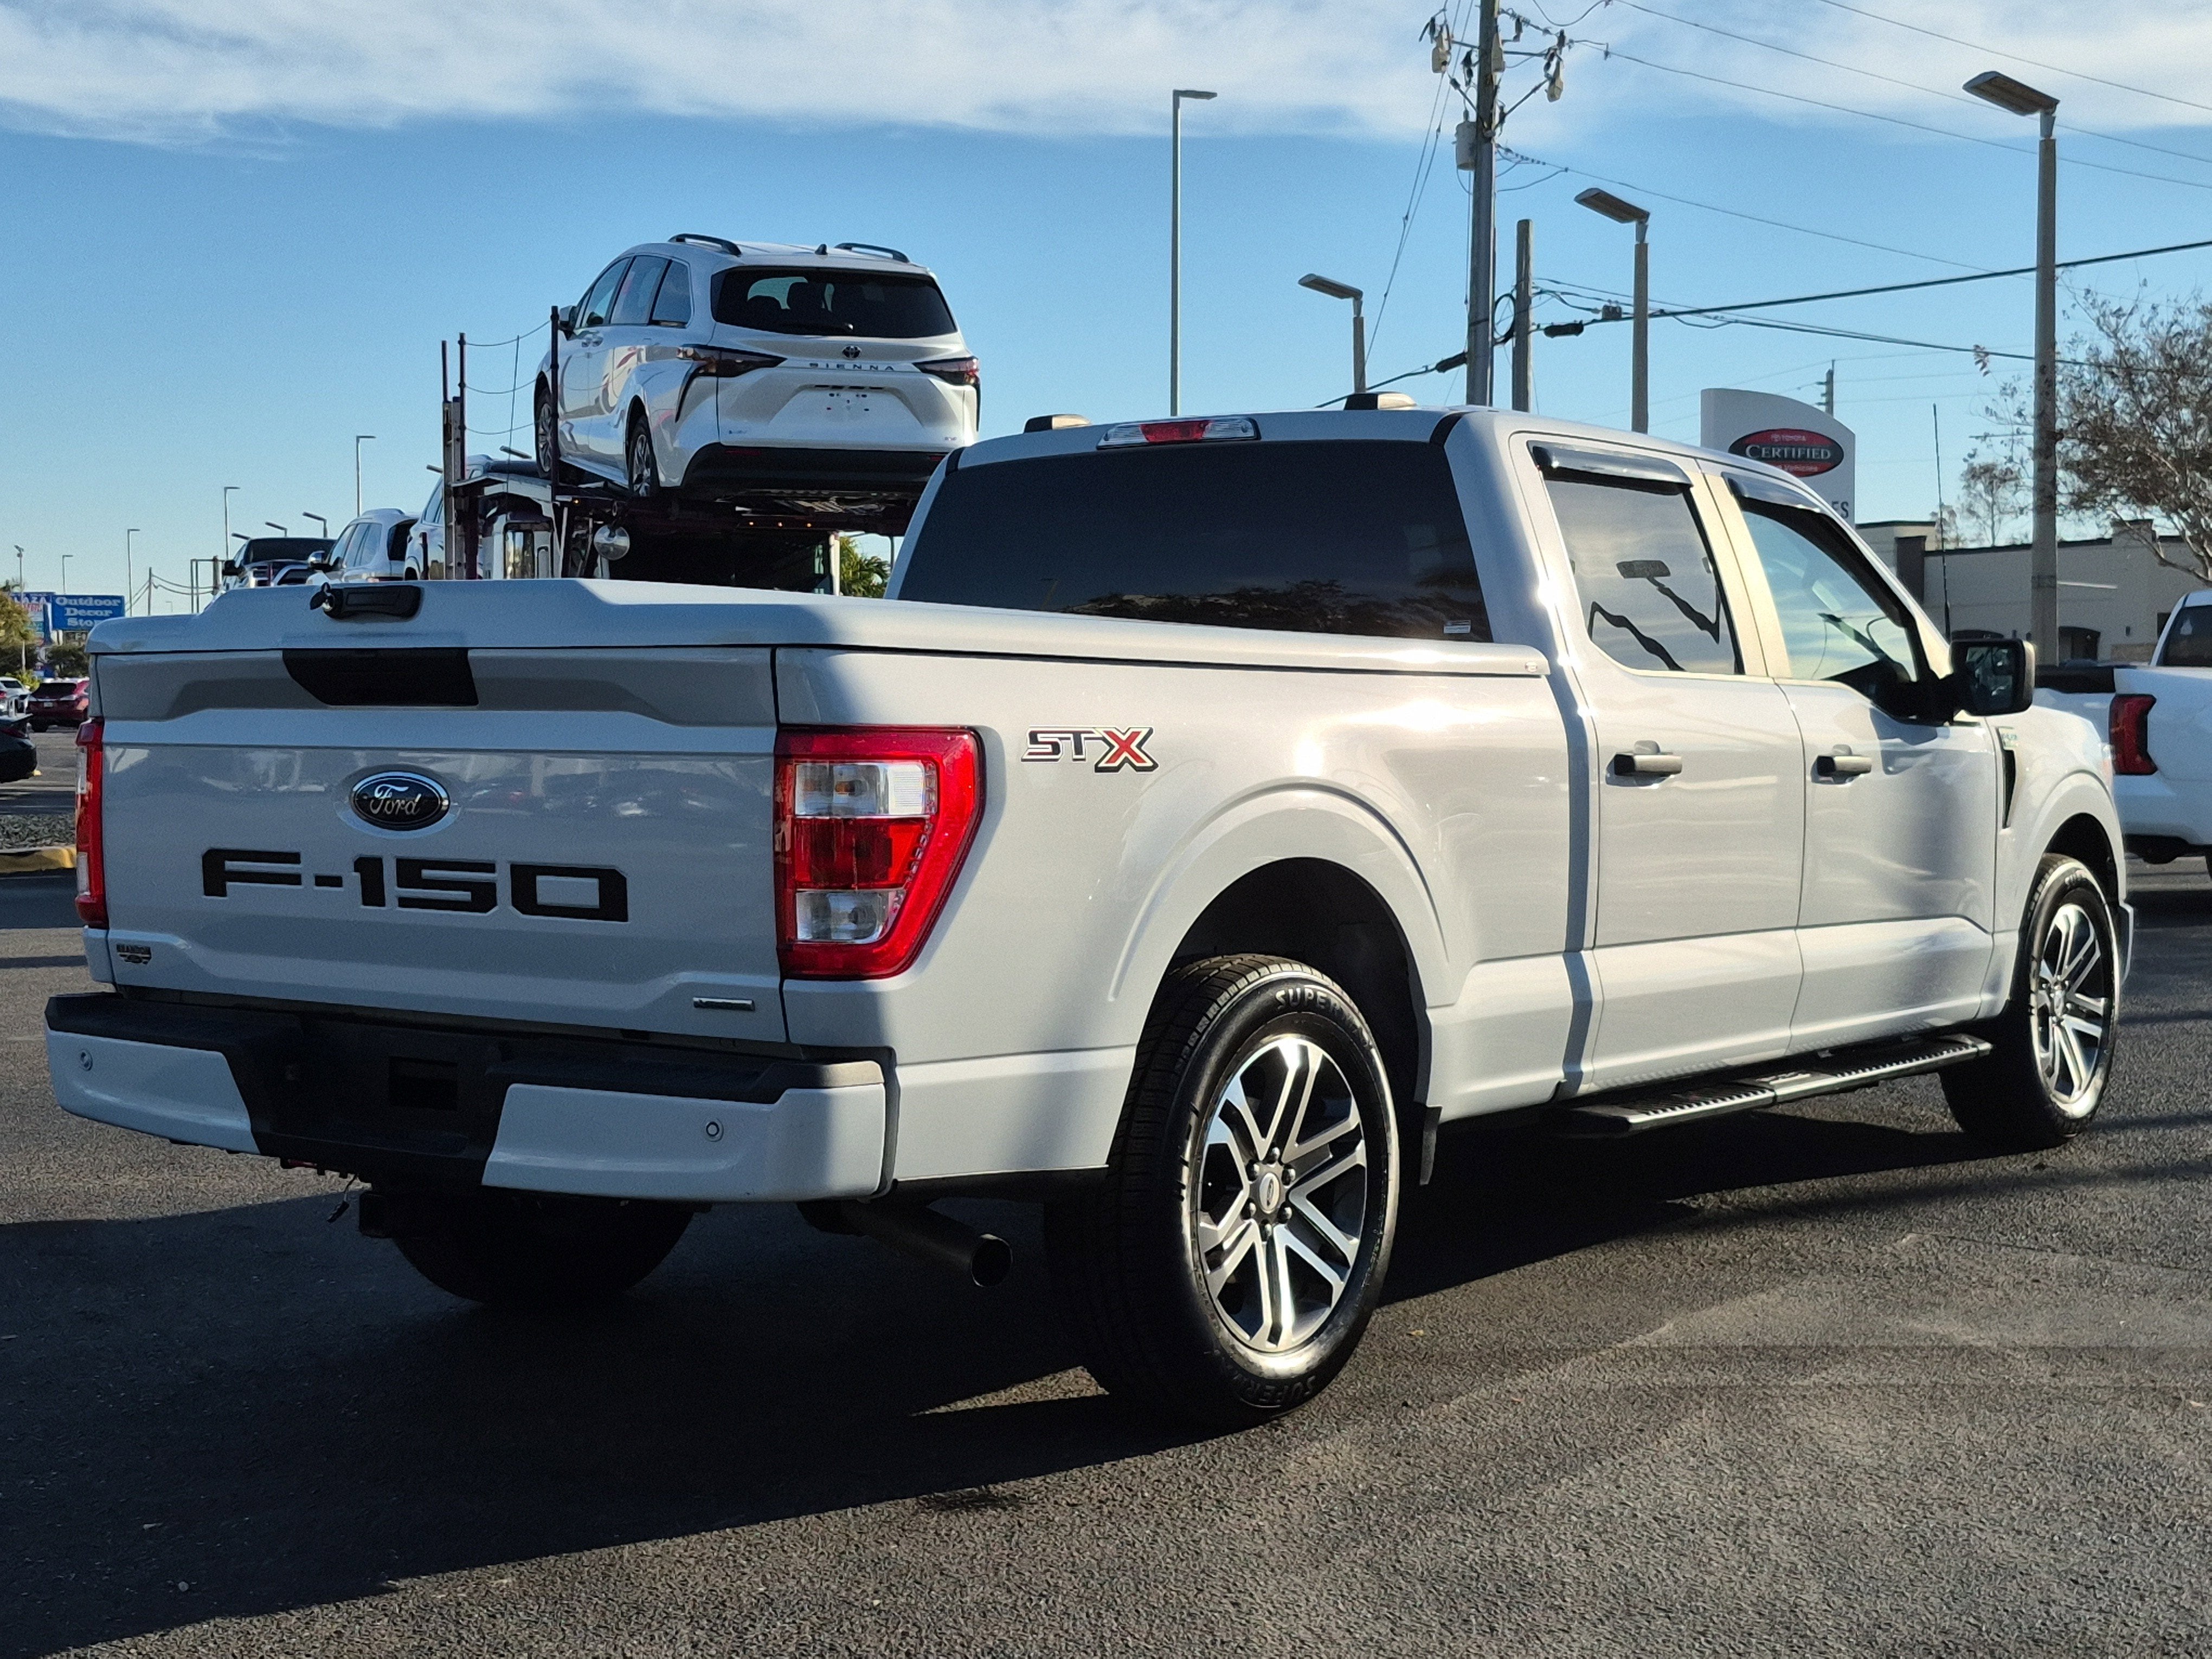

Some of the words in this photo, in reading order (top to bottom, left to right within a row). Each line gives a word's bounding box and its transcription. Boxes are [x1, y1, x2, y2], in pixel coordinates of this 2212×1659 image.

[809, 362, 894, 371] SIENNA
[56, 597, 121, 606] Outdoor
[65, 607, 113, 616] Decor
[67, 618, 102, 626] Sto
[1020, 726, 1159, 773] STX
[371, 783, 421, 816] Ford
[201, 848, 629, 923] F-150
